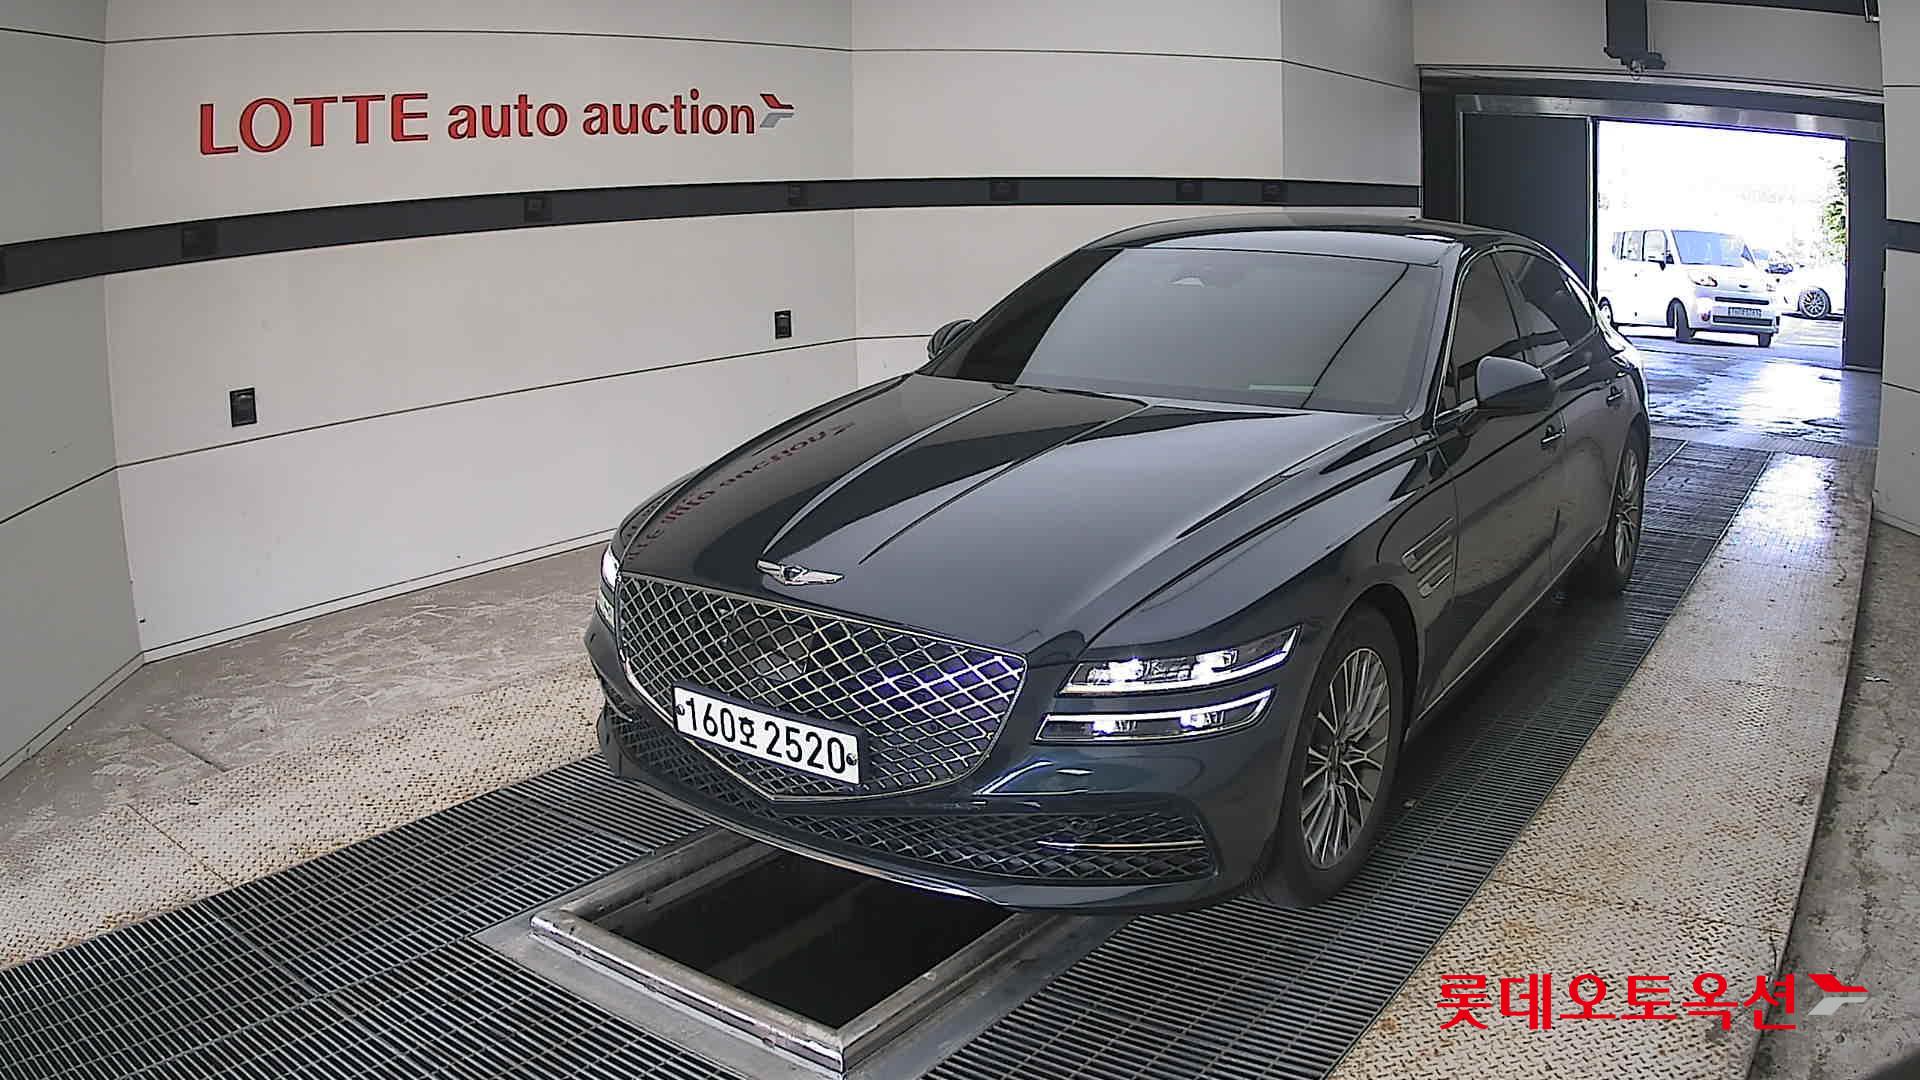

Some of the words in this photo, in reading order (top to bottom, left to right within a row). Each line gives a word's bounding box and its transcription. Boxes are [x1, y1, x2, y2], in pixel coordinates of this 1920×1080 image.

[200, 92, 428, 156] LOTTE
[447, 94, 568, 140] auto
[582, 89, 755, 137] auction
[685, 697, 758, 750] 160호
[763, 720, 846, 774] 2520
